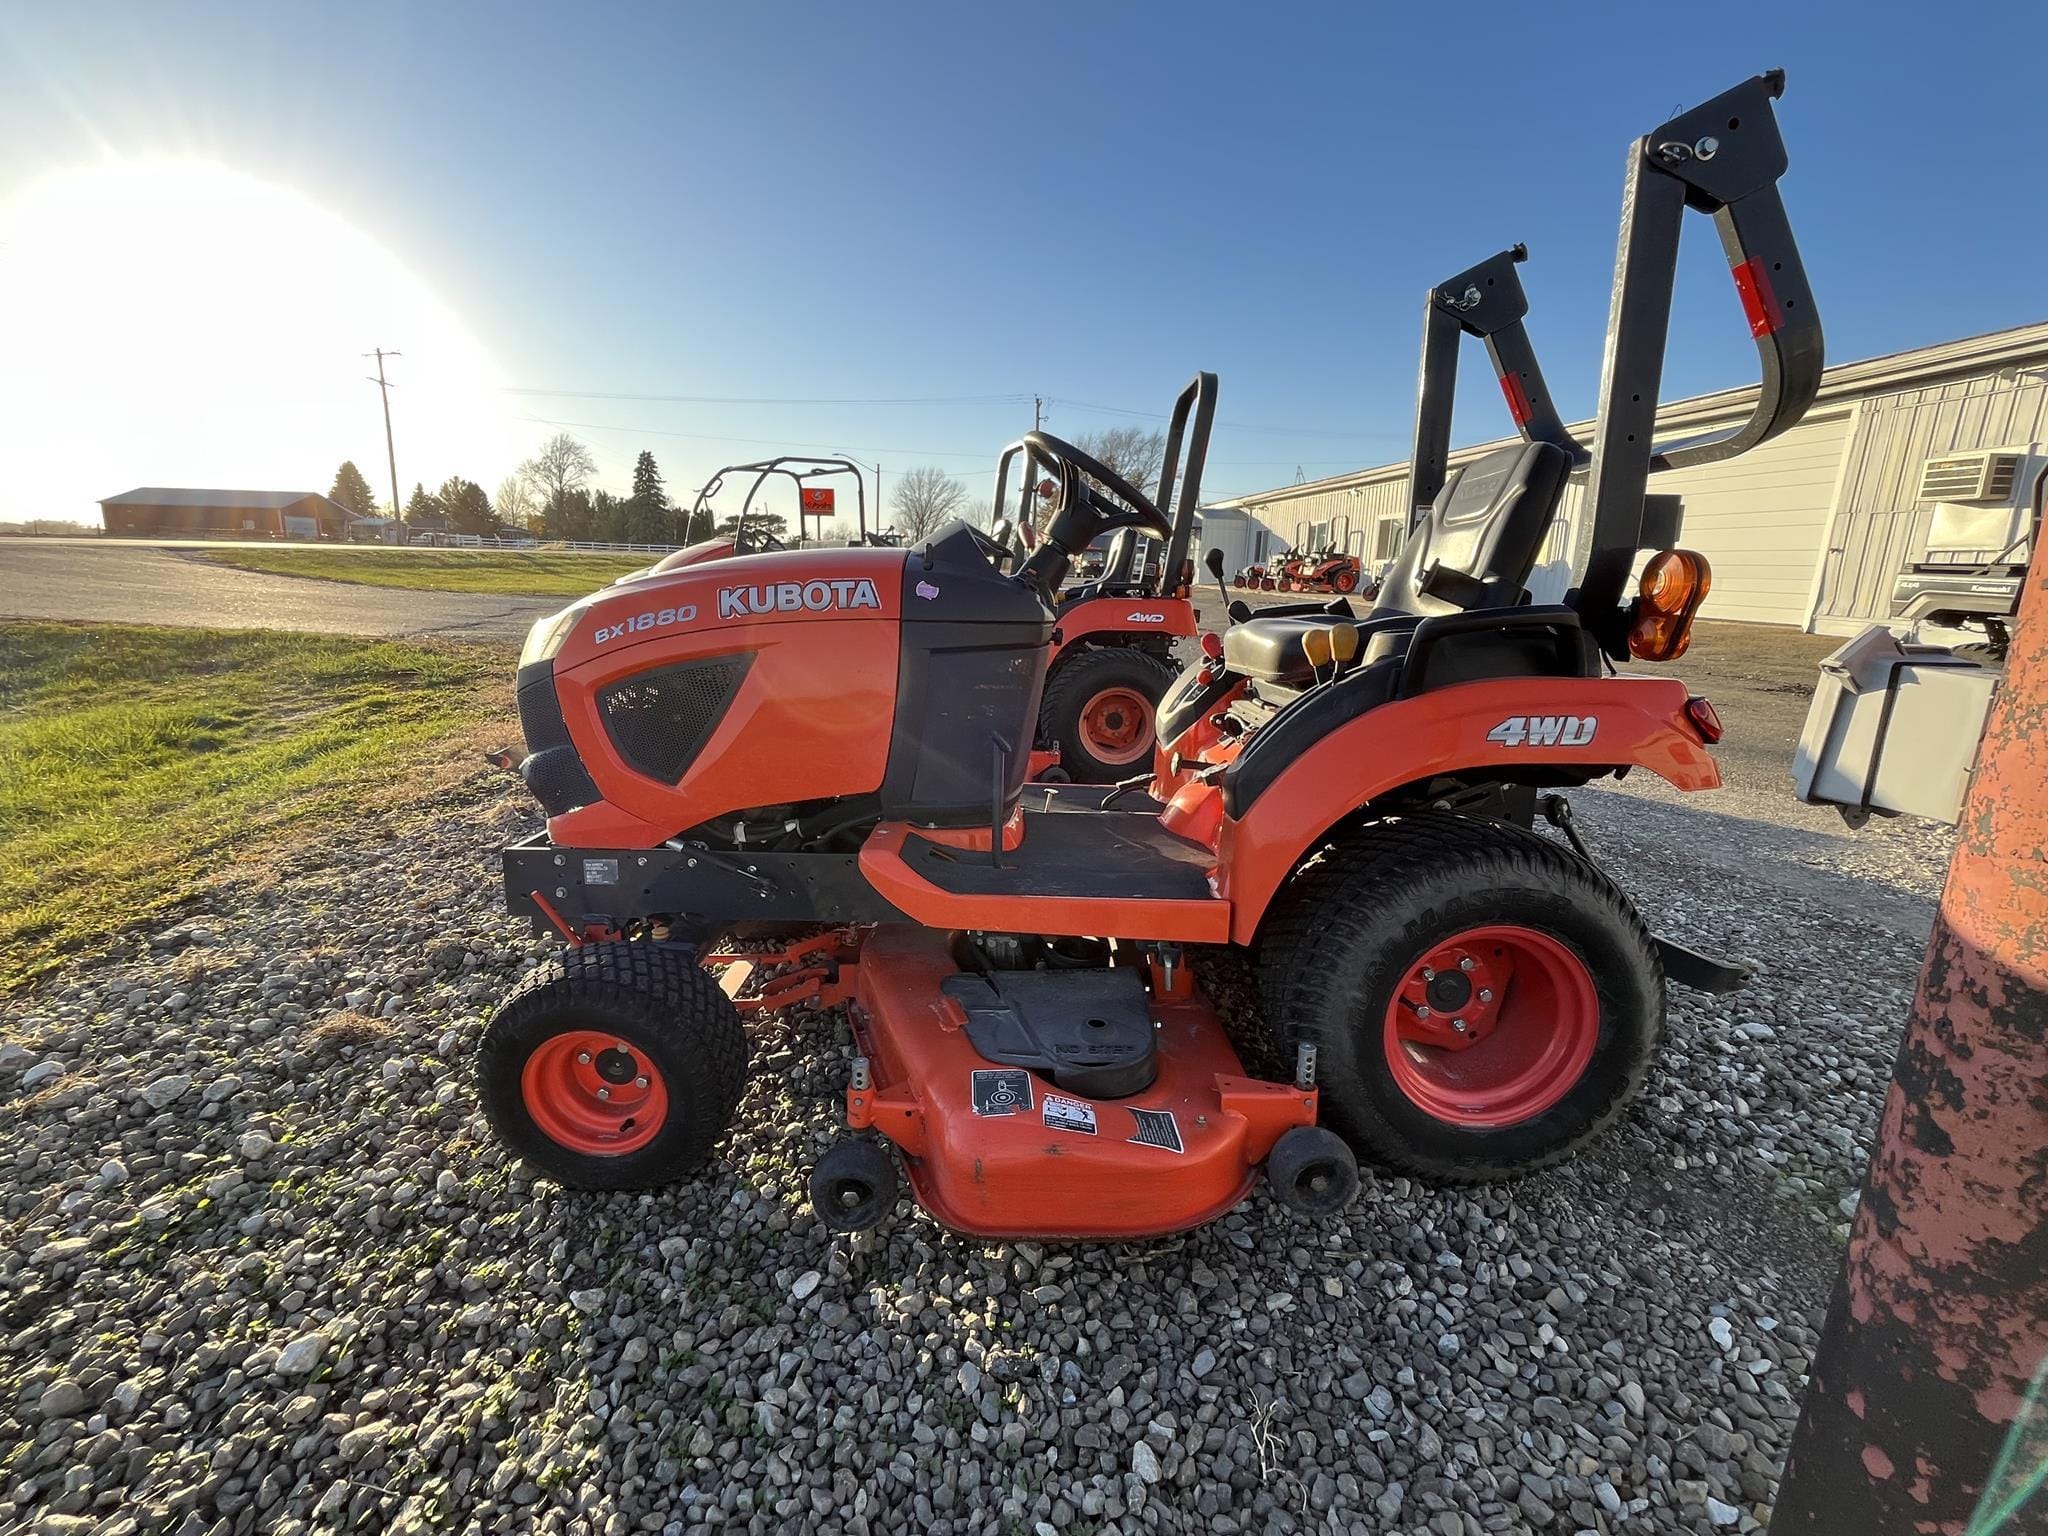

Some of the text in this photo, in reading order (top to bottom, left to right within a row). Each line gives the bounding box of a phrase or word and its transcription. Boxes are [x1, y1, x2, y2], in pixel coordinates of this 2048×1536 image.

[718, 580, 880, 617] KUBOTA
[594, 605, 697, 645] BX1880
[1127, 611, 1165, 623] 4WD
[1486, 715, 1598, 747] 4WD
[1402, 887, 1572, 942] MASTER
[1055, 1043, 1137, 1056] NO STEP
[1054, 1097, 1092, 1110] DANGER
